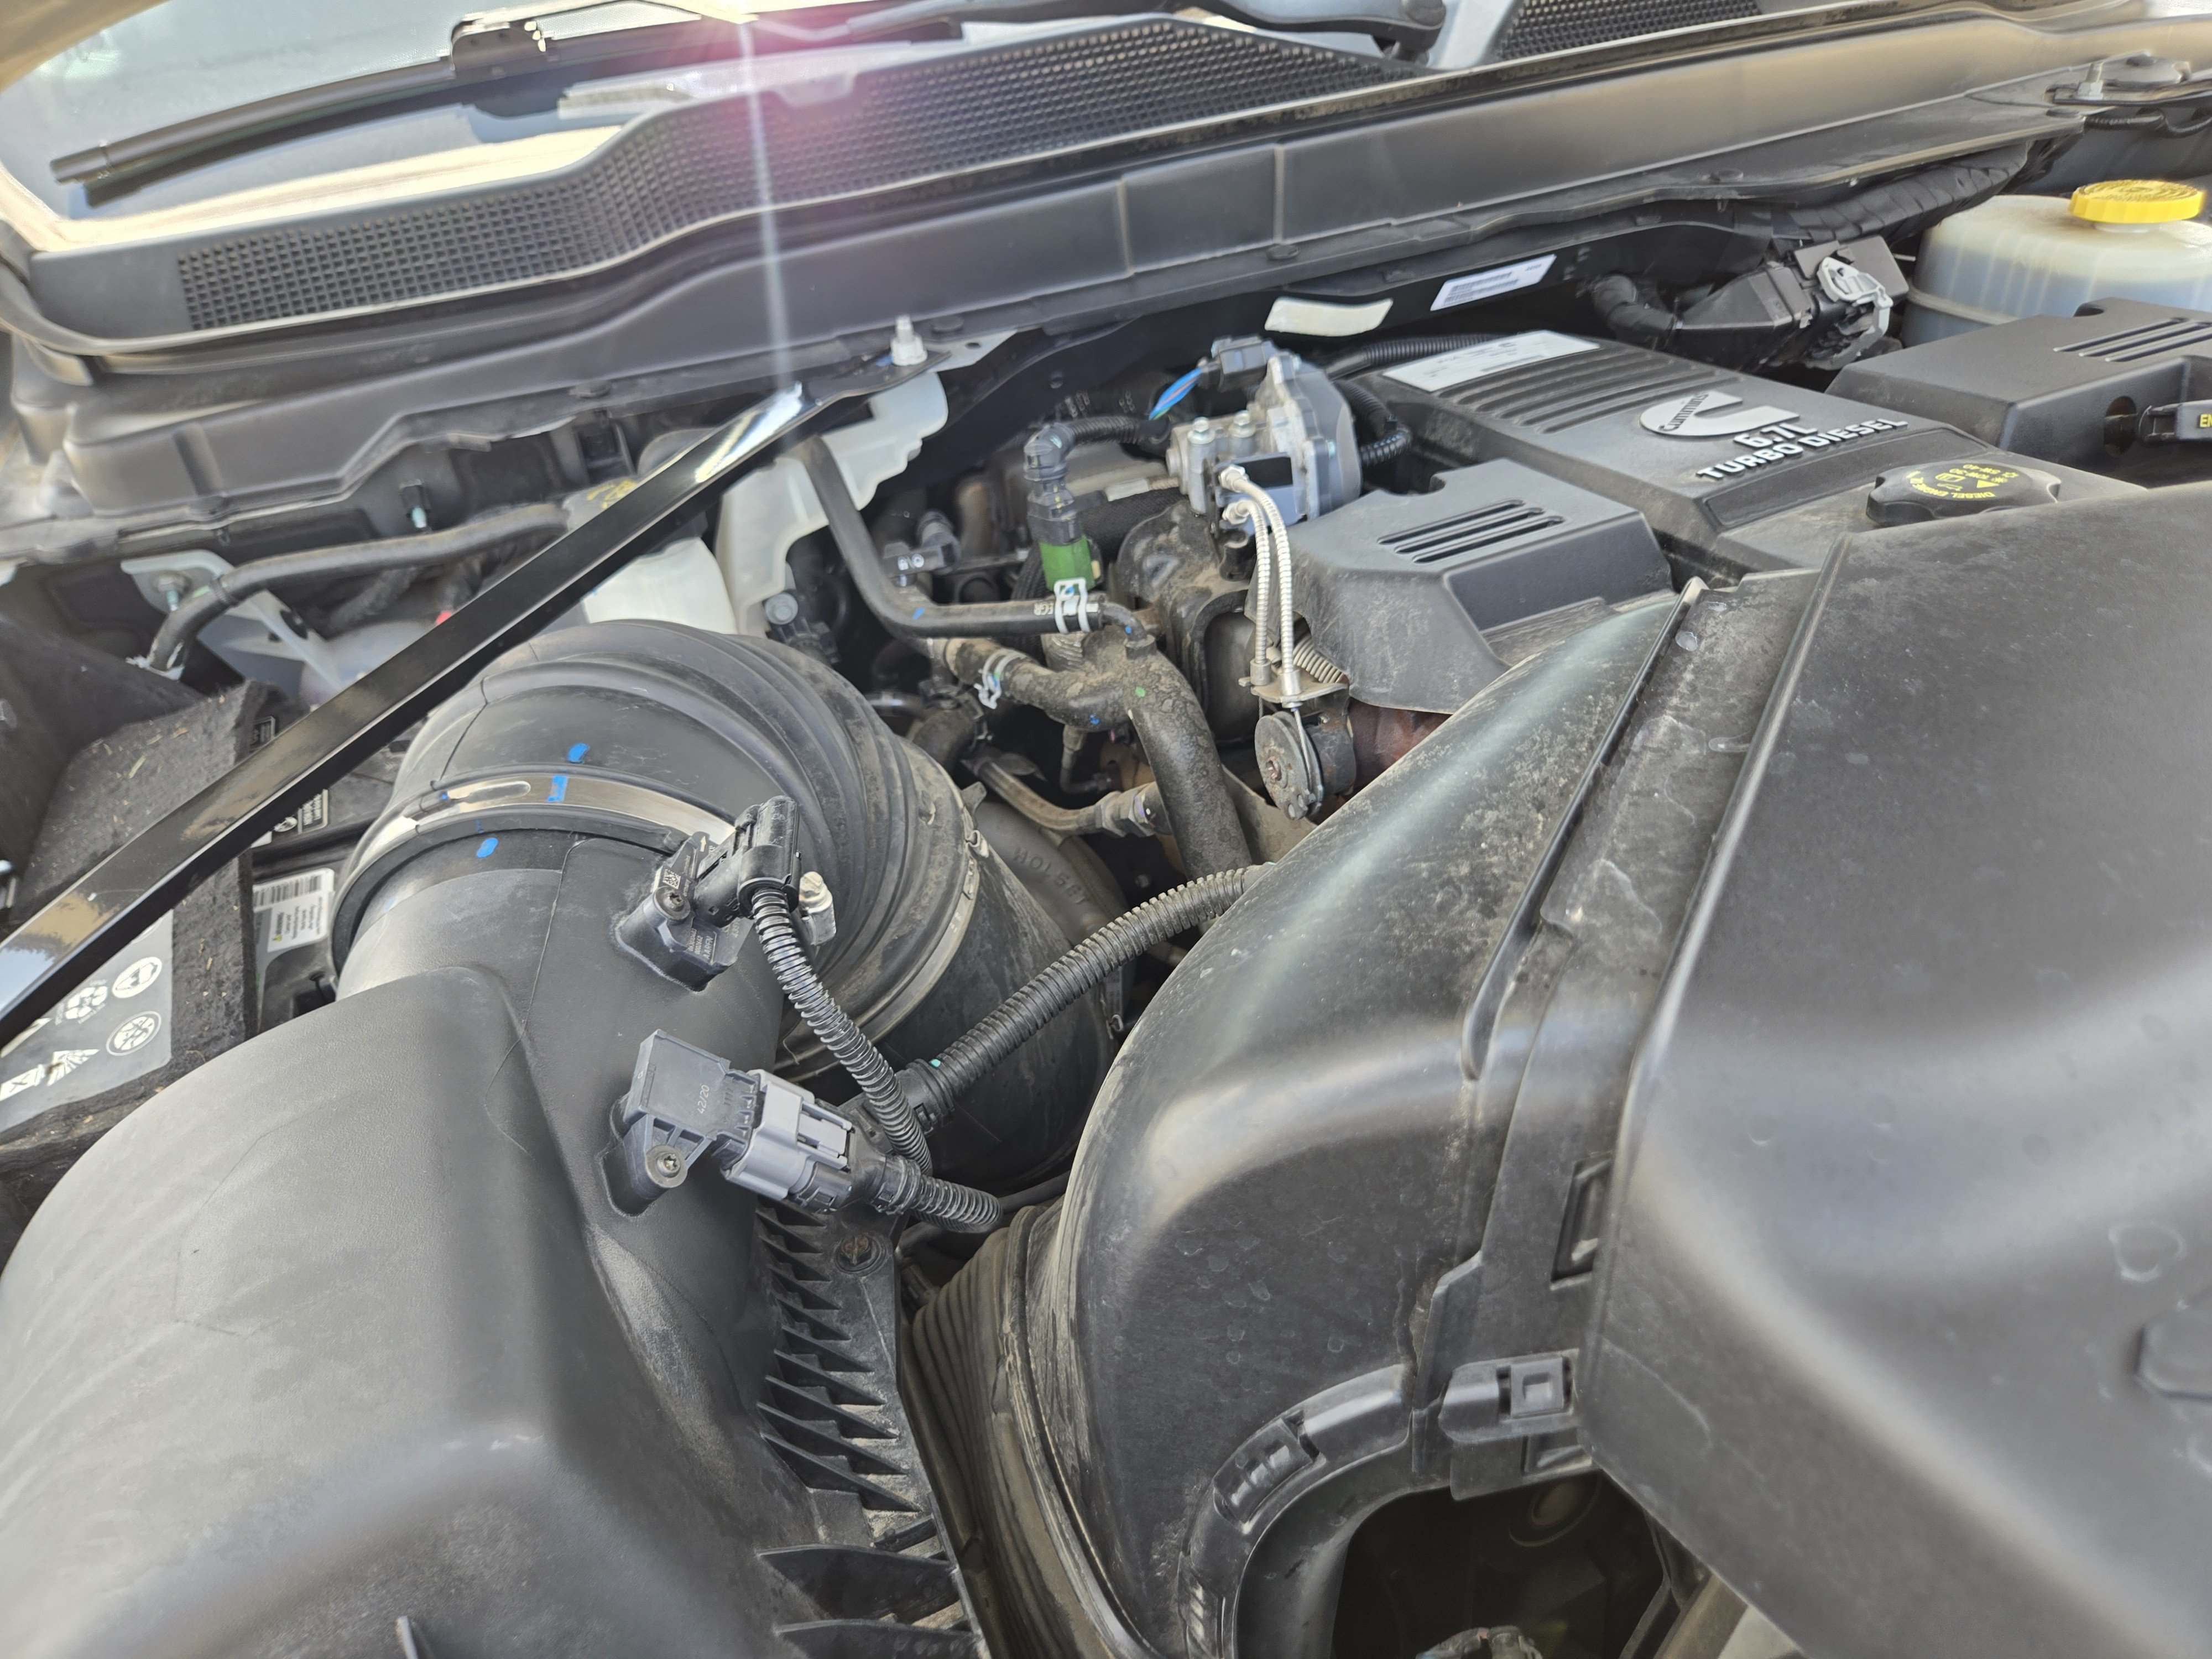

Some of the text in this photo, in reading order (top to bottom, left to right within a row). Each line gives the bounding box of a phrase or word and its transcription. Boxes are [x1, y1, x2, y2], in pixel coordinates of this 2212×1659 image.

[1658, 394, 1709, 432] Cummins
[1696, 418, 1908, 480] TURBO DIESEL
[1733, 422, 1818, 449] 6.7L
[697, 1084, 710, 1114] 42/20
